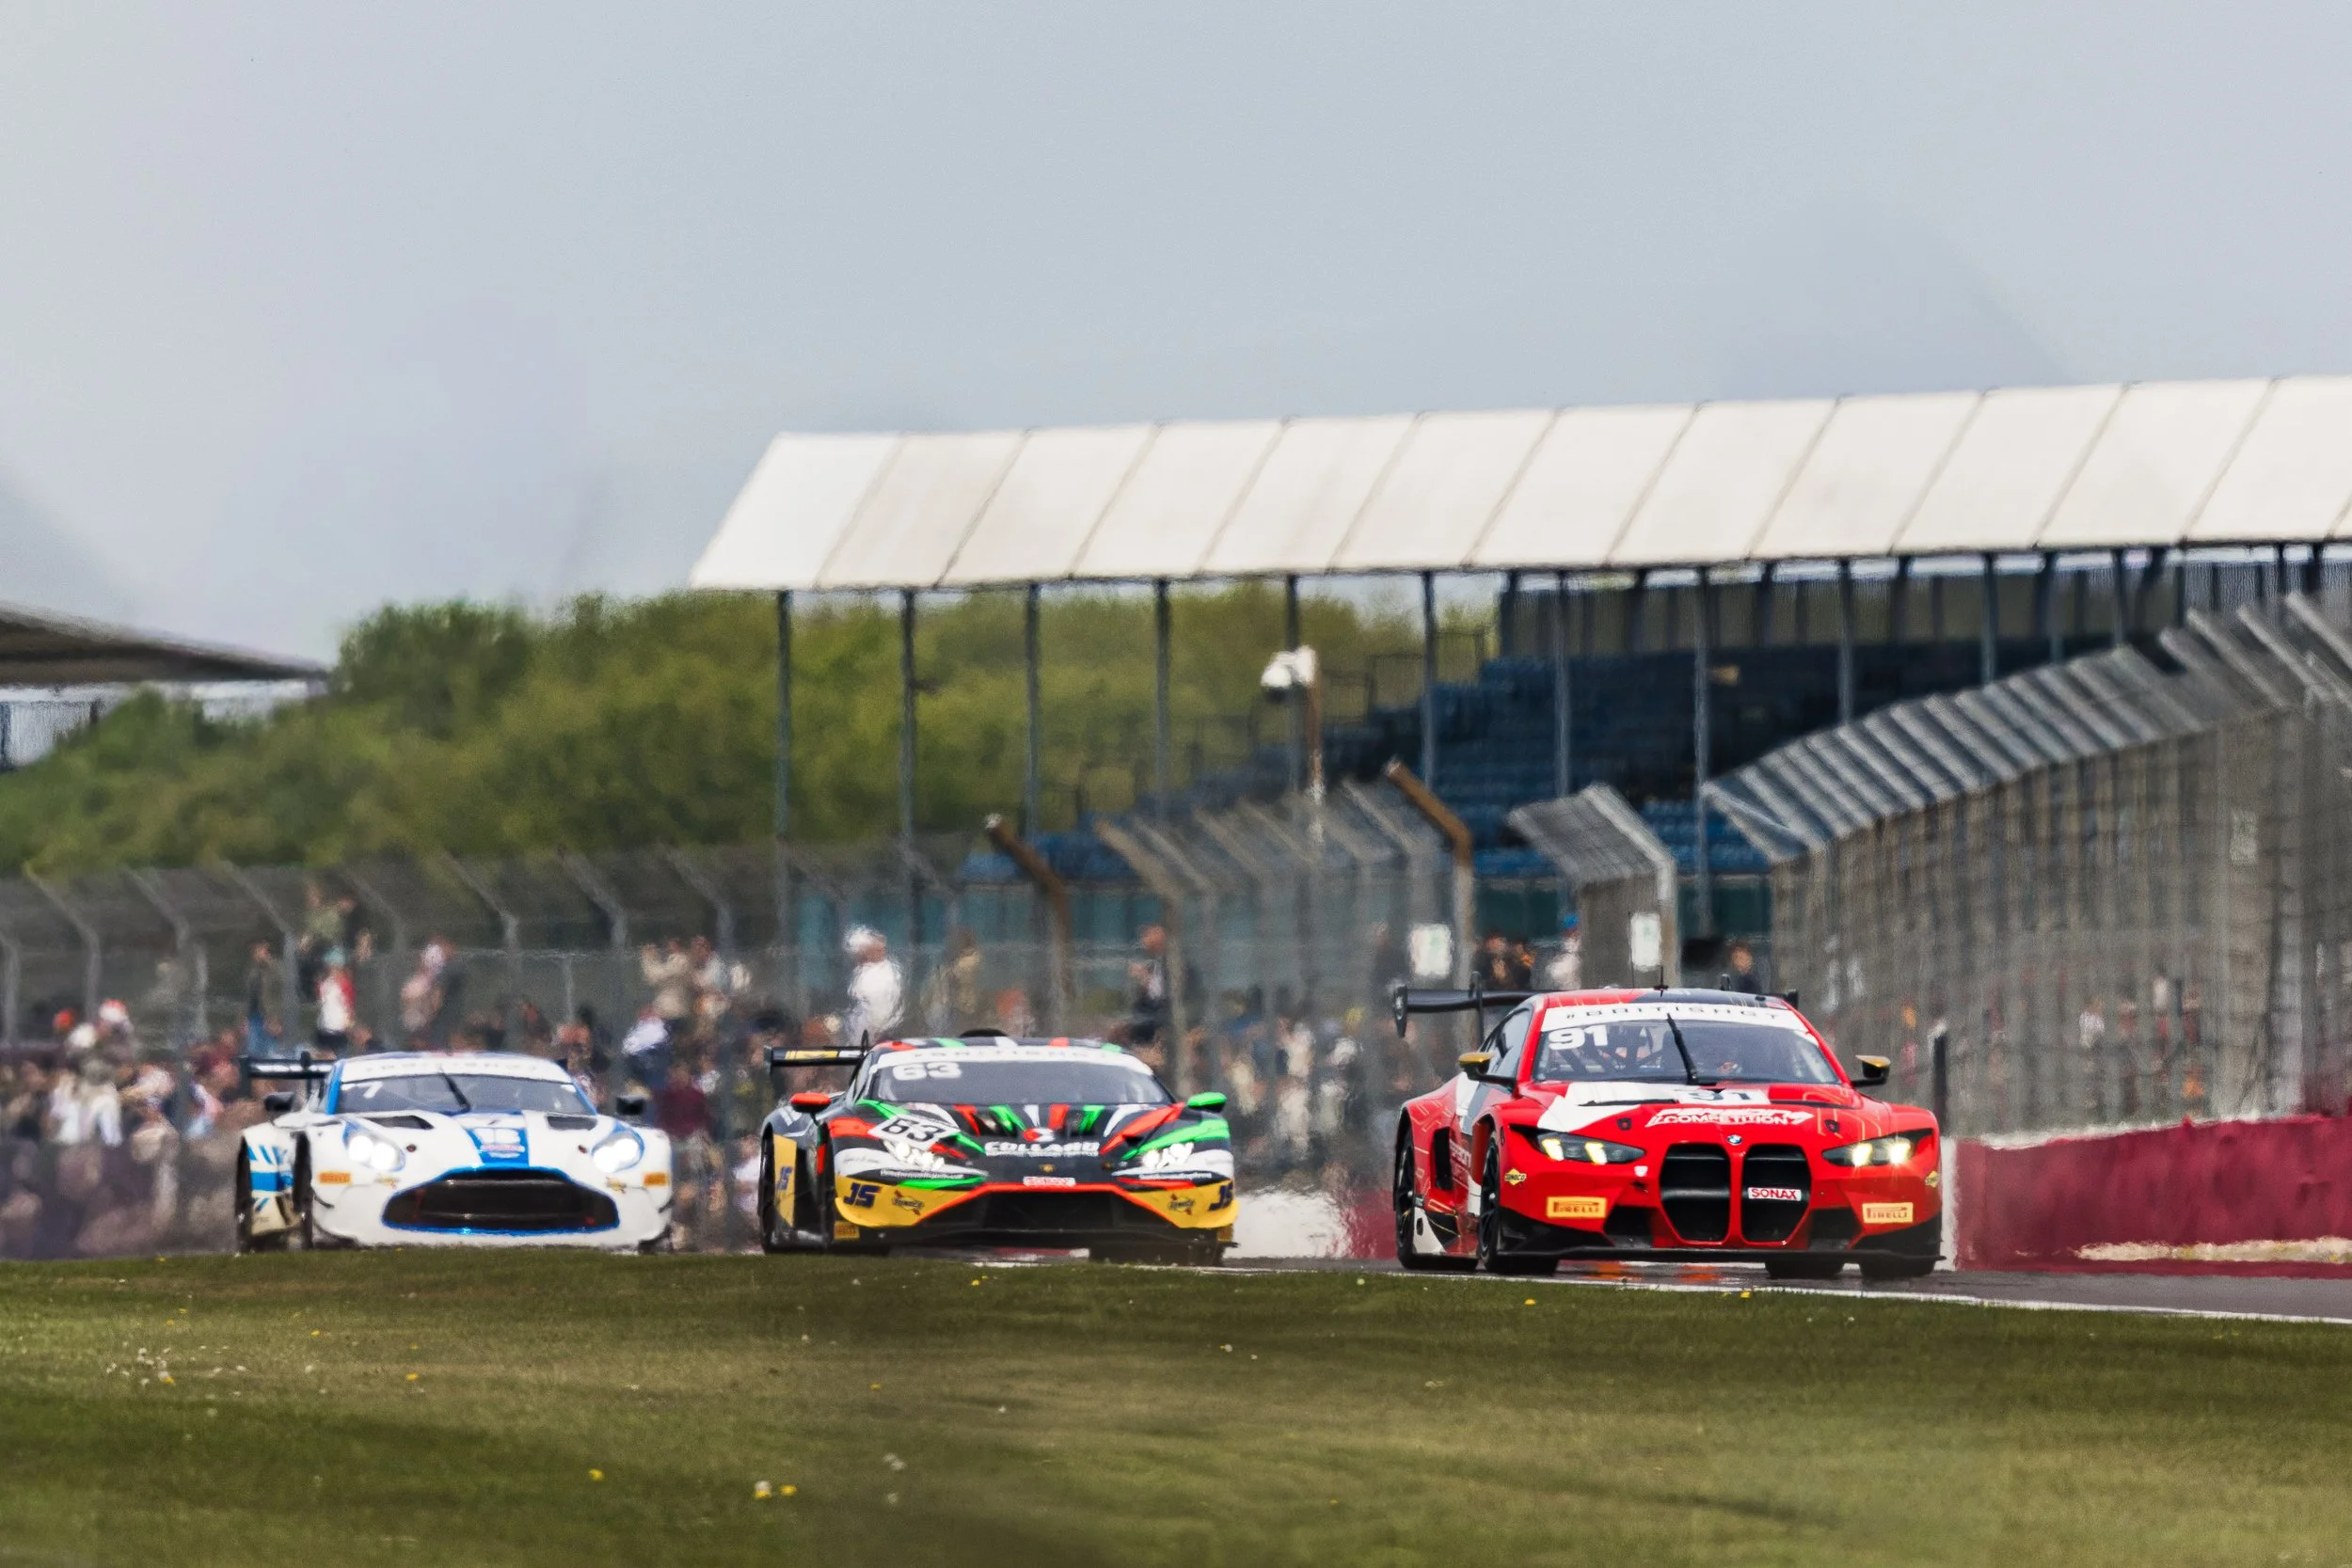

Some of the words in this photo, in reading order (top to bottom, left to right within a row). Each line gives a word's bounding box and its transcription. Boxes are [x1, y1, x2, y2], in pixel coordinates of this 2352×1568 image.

[1549, 1024, 1609, 1050] 91
[893, 1061, 962, 1082] 63
[357, 1081, 384, 1099] 7
[882, 1118, 947, 1142] 63
[843, 1182, 882, 1209] JS
[1751, 1188, 1798, 1200] SONAX
[1553, 1201, 1599, 1212] PIRELLI
[1866, 1206, 1908, 1219] PIRELLI
